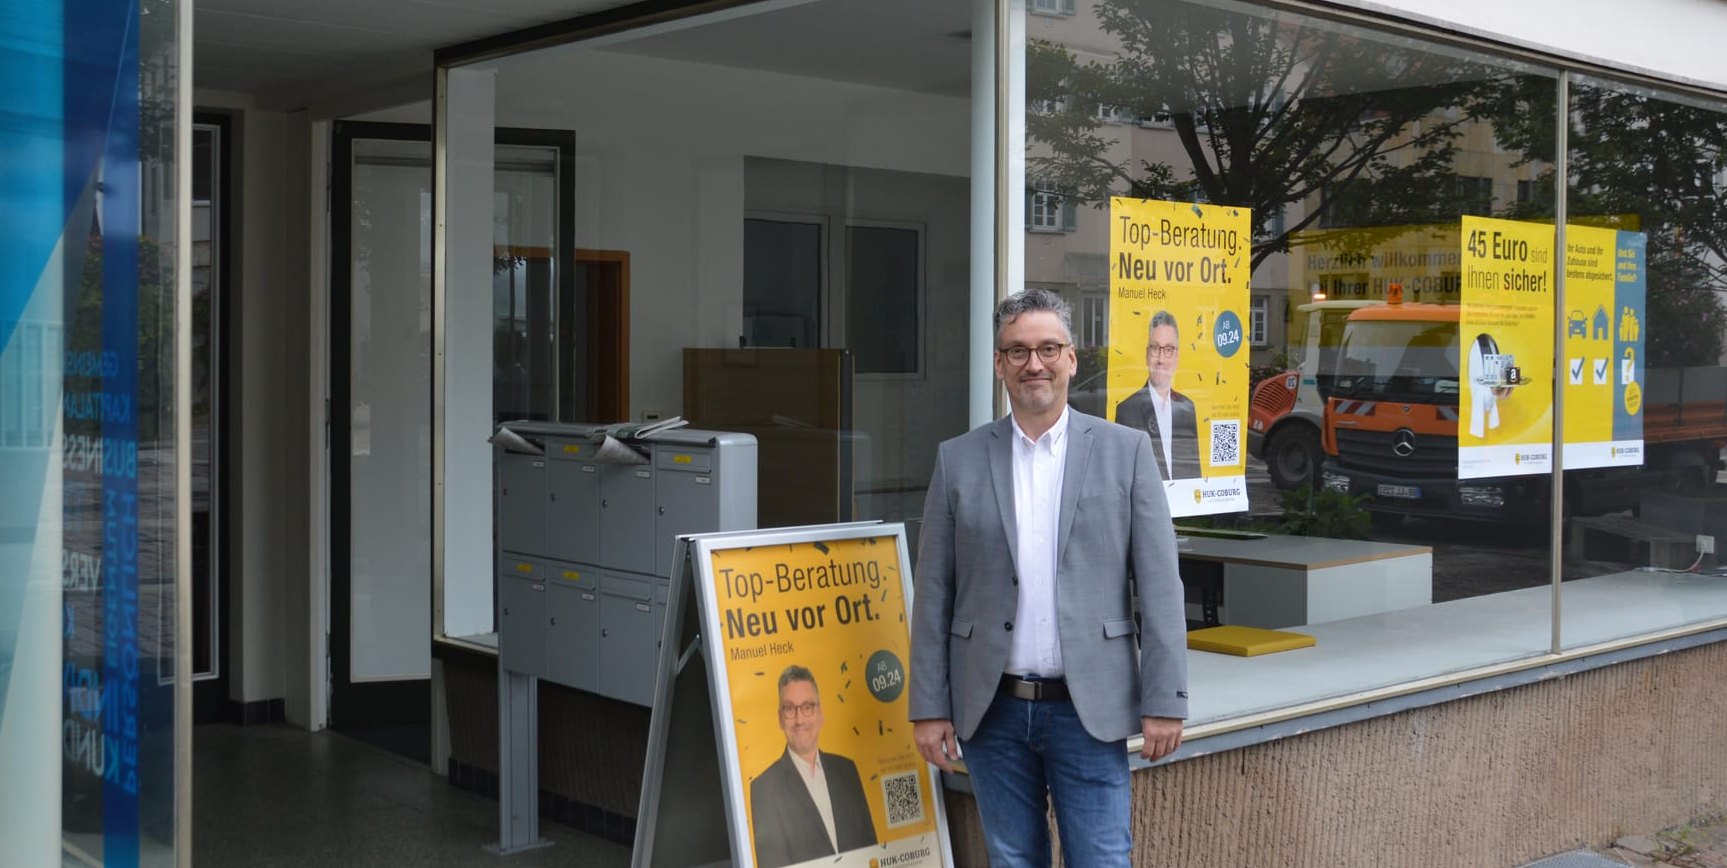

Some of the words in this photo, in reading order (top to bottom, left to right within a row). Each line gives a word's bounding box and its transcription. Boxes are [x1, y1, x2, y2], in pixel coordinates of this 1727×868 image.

[1119, 215, 1242, 256] Top-Beratung.
[1467, 229, 1487, 258] 45
[1493, 231, 1528, 262] Euro
[1530, 247, 1548, 264] sind
[1575, 244, 1586, 254] Auto
[1587, 246, 1596, 255] und
[1119, 252, 1156, 281] Neu
[1164, 259, 1193, 282] vor
[1200, 256, 1231, 284] Ort.
[1307, 252, 1367, 270] Herzlich
[1333, 278, 1369, 296] Ihrer
[1467, 265, 1500, 290] Ihnen
[1503, 268, 1547, 293] sicher!
[1118, 286, 1145, 299] Manuel
[1147, 287, 1166, 300] Heck
[1222, 320, 1230, 330] AB
[1217, 329, 1240, 347] 09.24
[1202, 487, 1241, 499] HUK-COBURG
[719, 558, 887, 602] Top-Beratung.
[726, 606, 778, 640] Neu
[786, 603, 826, 632] vor
[835, 593, 880, 626] Ort.
[730, 645, 767, 662] Manuel
[769, 640, 794, 656] Heck
[876, 659, 888, 673] AB
[872, 668, 901, 692] 09.24
[880, 846, 931, 867] HUK-COBURG
